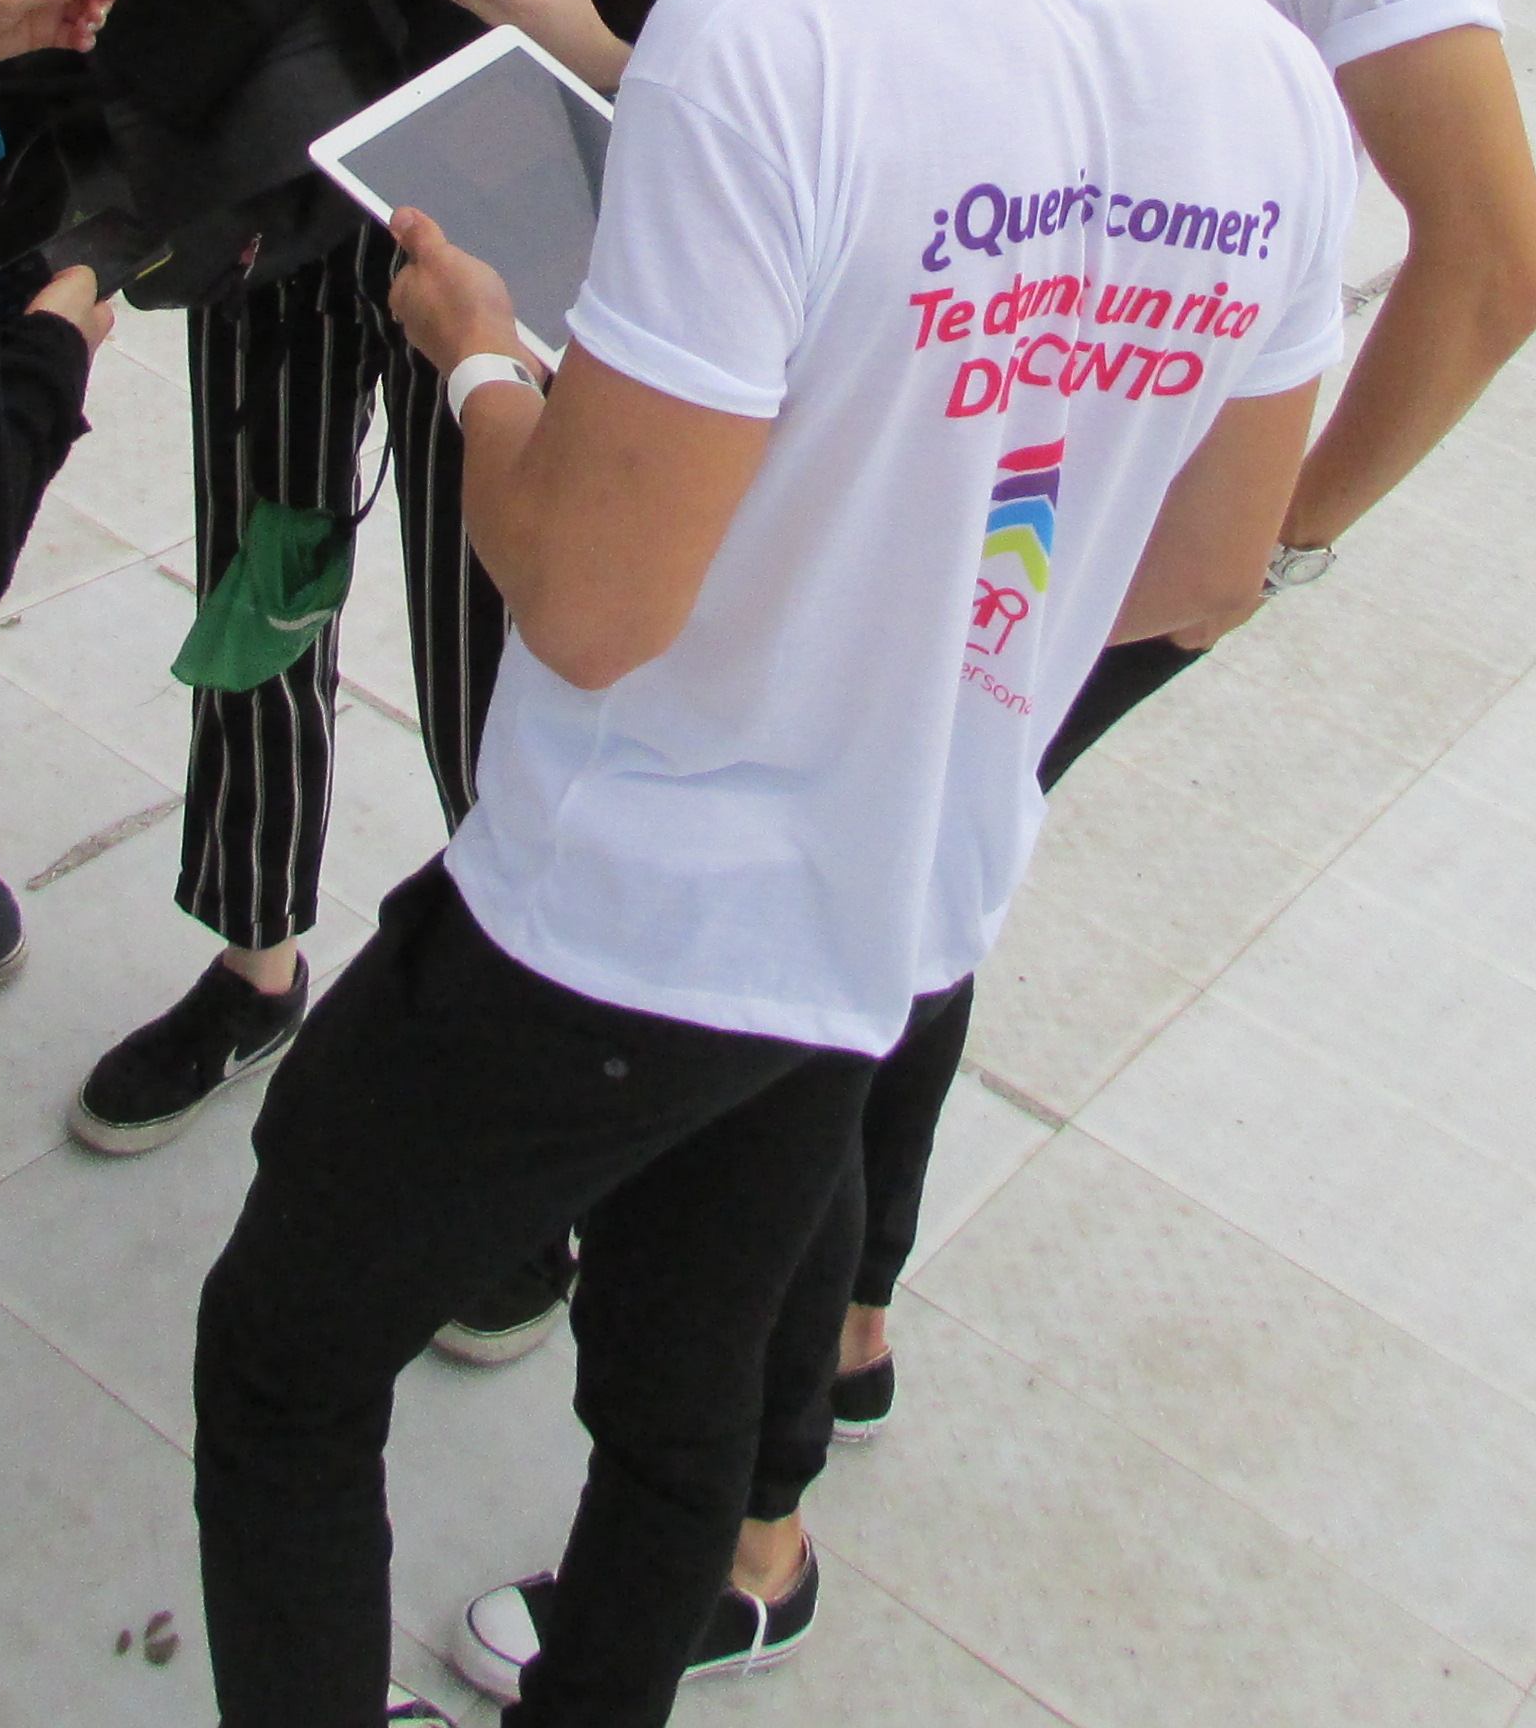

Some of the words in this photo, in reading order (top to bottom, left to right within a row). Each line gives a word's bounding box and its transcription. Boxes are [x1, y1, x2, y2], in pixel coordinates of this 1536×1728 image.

[921, 168, 1102, 273] ¿Quers
[1105, 193, 1281, 260] comer?
[909, 287, 976, 351] Te
[1094, 283, 1173, 330] un
[1171, 281, 1261, 340] rico
